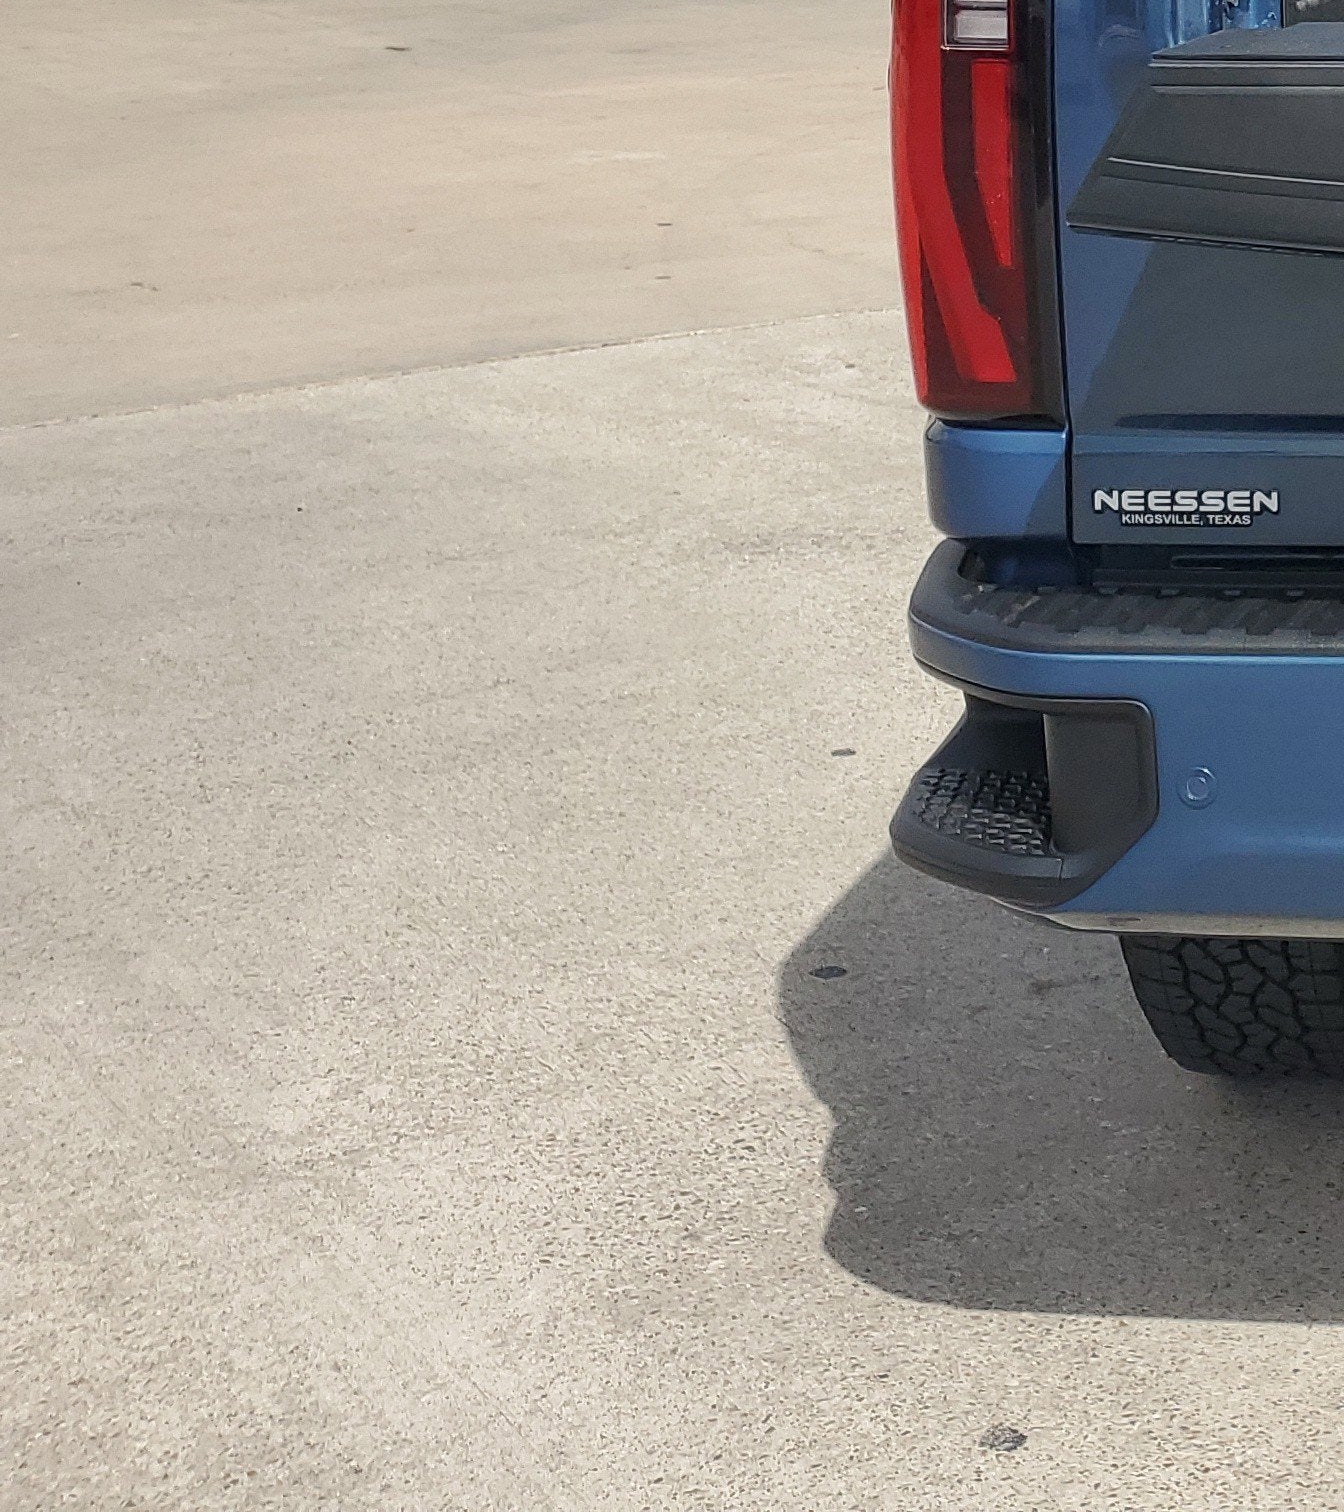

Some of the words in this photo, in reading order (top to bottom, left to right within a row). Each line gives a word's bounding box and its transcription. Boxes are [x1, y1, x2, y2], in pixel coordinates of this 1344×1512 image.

[1093, 490, 1279, 512] NEESSEN
[1121, 513, 1204, 526] KINGSVILLE,
[1209, 514, 1252, 525] TEXAS
